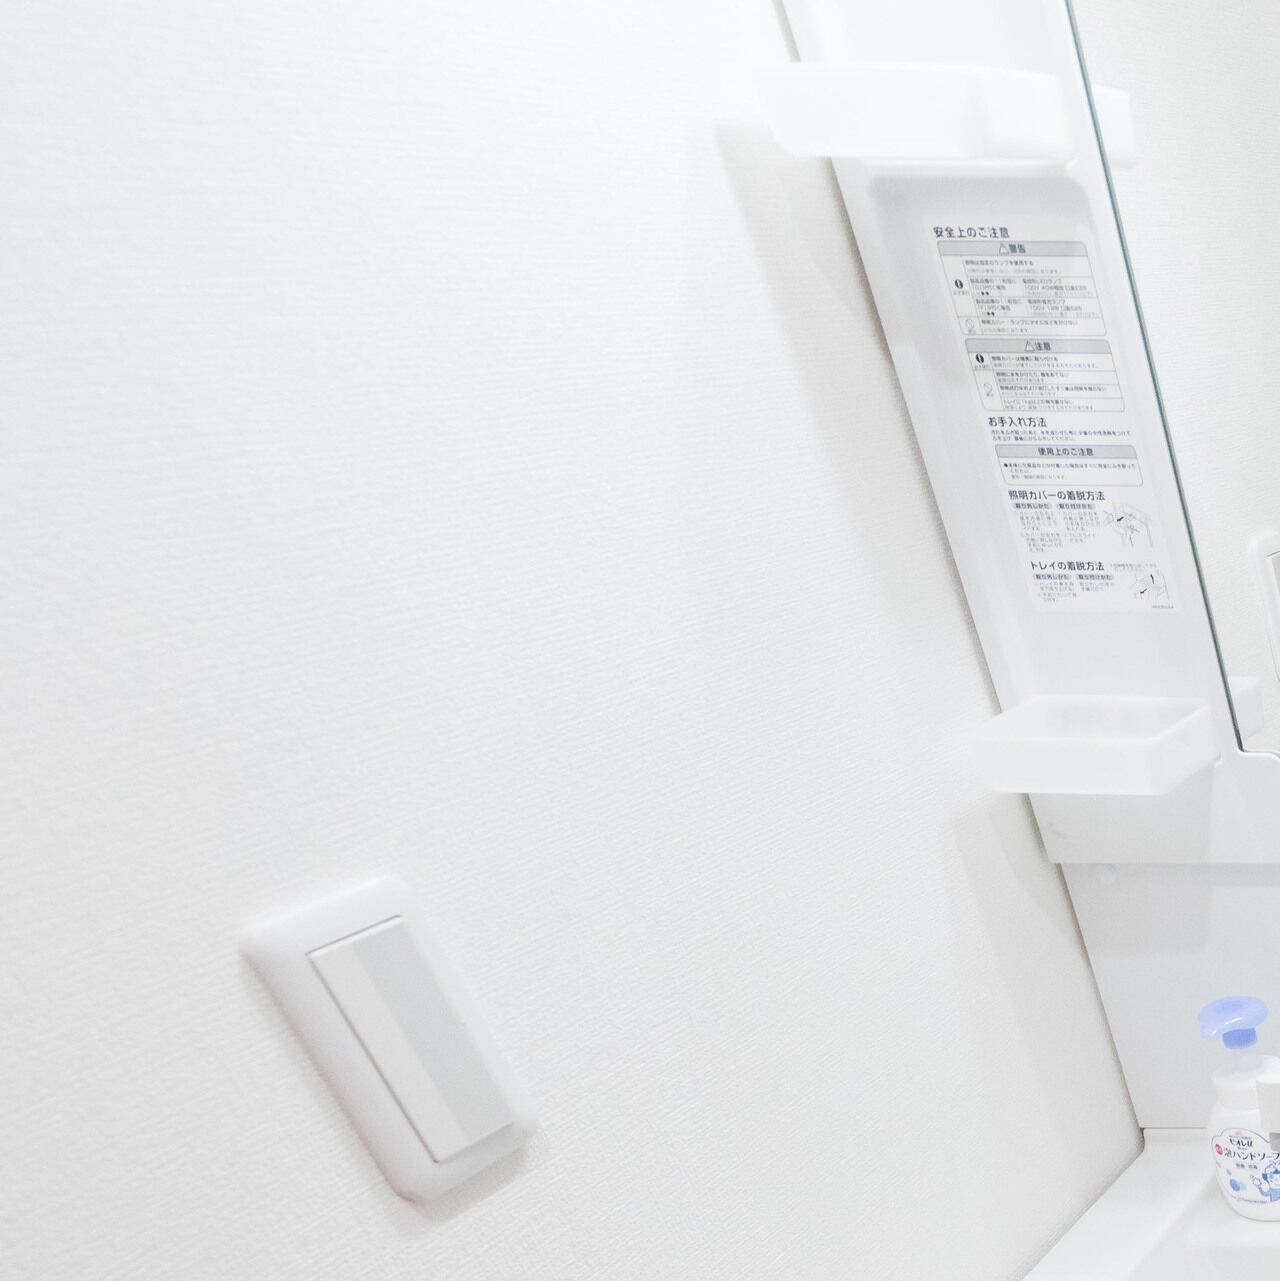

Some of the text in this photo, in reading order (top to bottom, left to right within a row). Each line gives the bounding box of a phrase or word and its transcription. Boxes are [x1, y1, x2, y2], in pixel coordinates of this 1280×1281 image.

[933, 226, 1010, 239] 安全上のご注意
[1008, 243, 1026, 254] 警告
[1035, 342, 1051, 352] 注意
[988, 417, 1047, 427] お手入れ方法
[1038, 447, 1094, 456] 使用上のご注意
[1008, 490, 1106, 501] 照明カバーの着脱方法
[1030, 560, 1105, 571] トレイの着脱方法
[1224, 1148, 1280, 1160] 泡ハンドソープ
